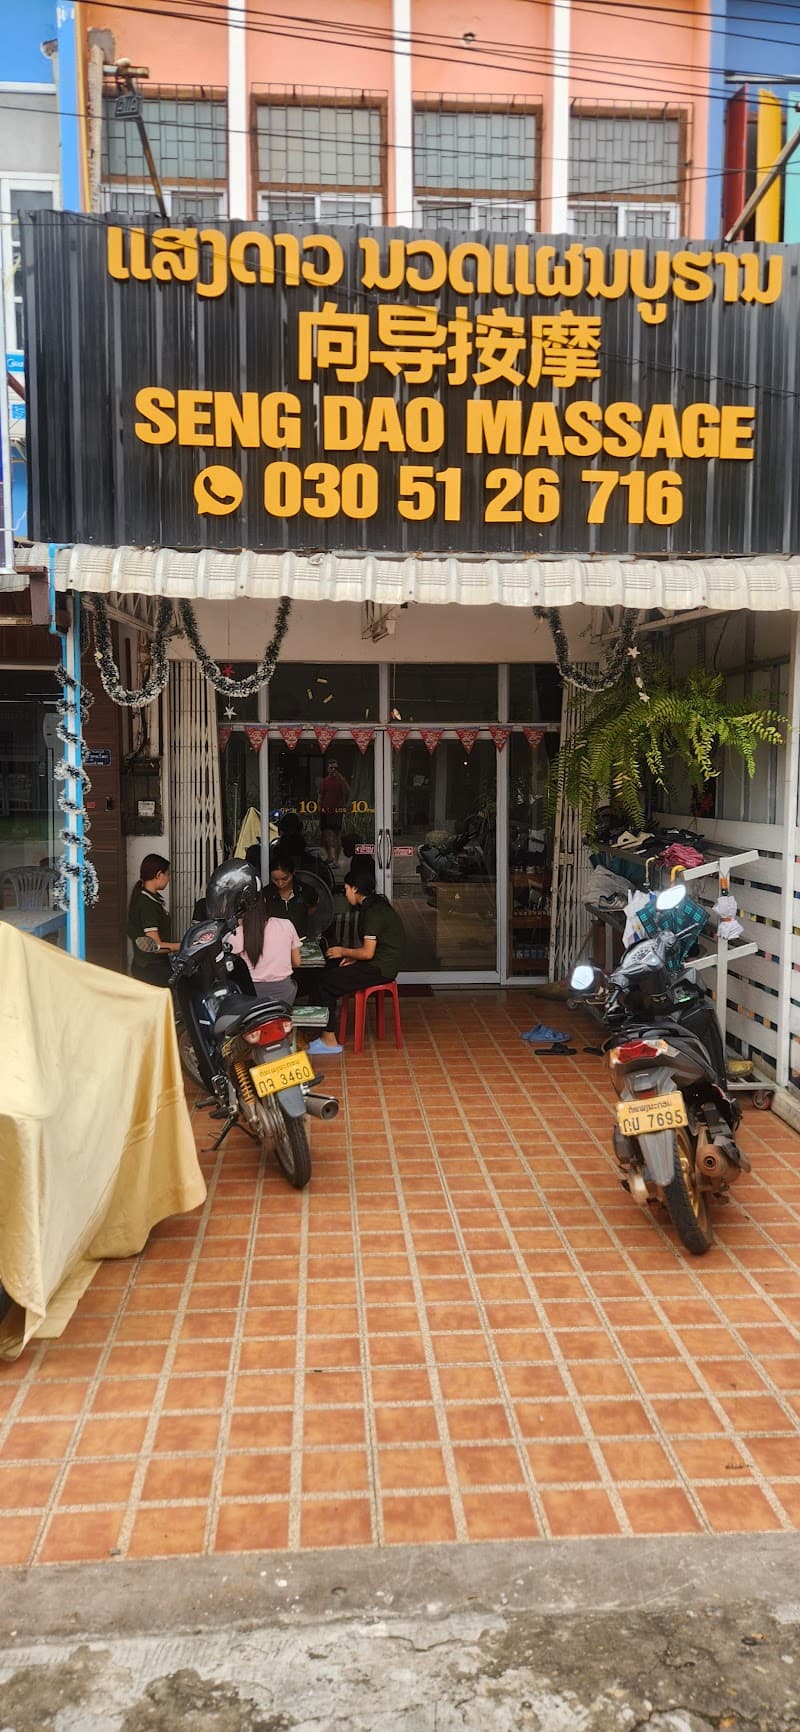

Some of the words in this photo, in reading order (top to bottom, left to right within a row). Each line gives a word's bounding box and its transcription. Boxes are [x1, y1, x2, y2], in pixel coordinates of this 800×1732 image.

[107, 226, 345, 297] ແສງດາວ
[359, 237, 783, 324] ນວດແຜນບູຮານ
[299, 302, 602, 388] 向导按摩
[134, 387, 301, 449] SENG
[323, 395, 445, 453] DAO
[466, 399, 756, 459] MASSAGE
[264, 461, 379, 519] 030
[398, 465, 462, 521] 51
[484, 468, 560, 523] 26
[581, 470, 684, 525] 716
[299, 800, 318, 814] 10
[351, 800, 368, 814] 10
[280, 1066, 310, 1085] 3460
[647, 1110, 684, 1129] 7695
